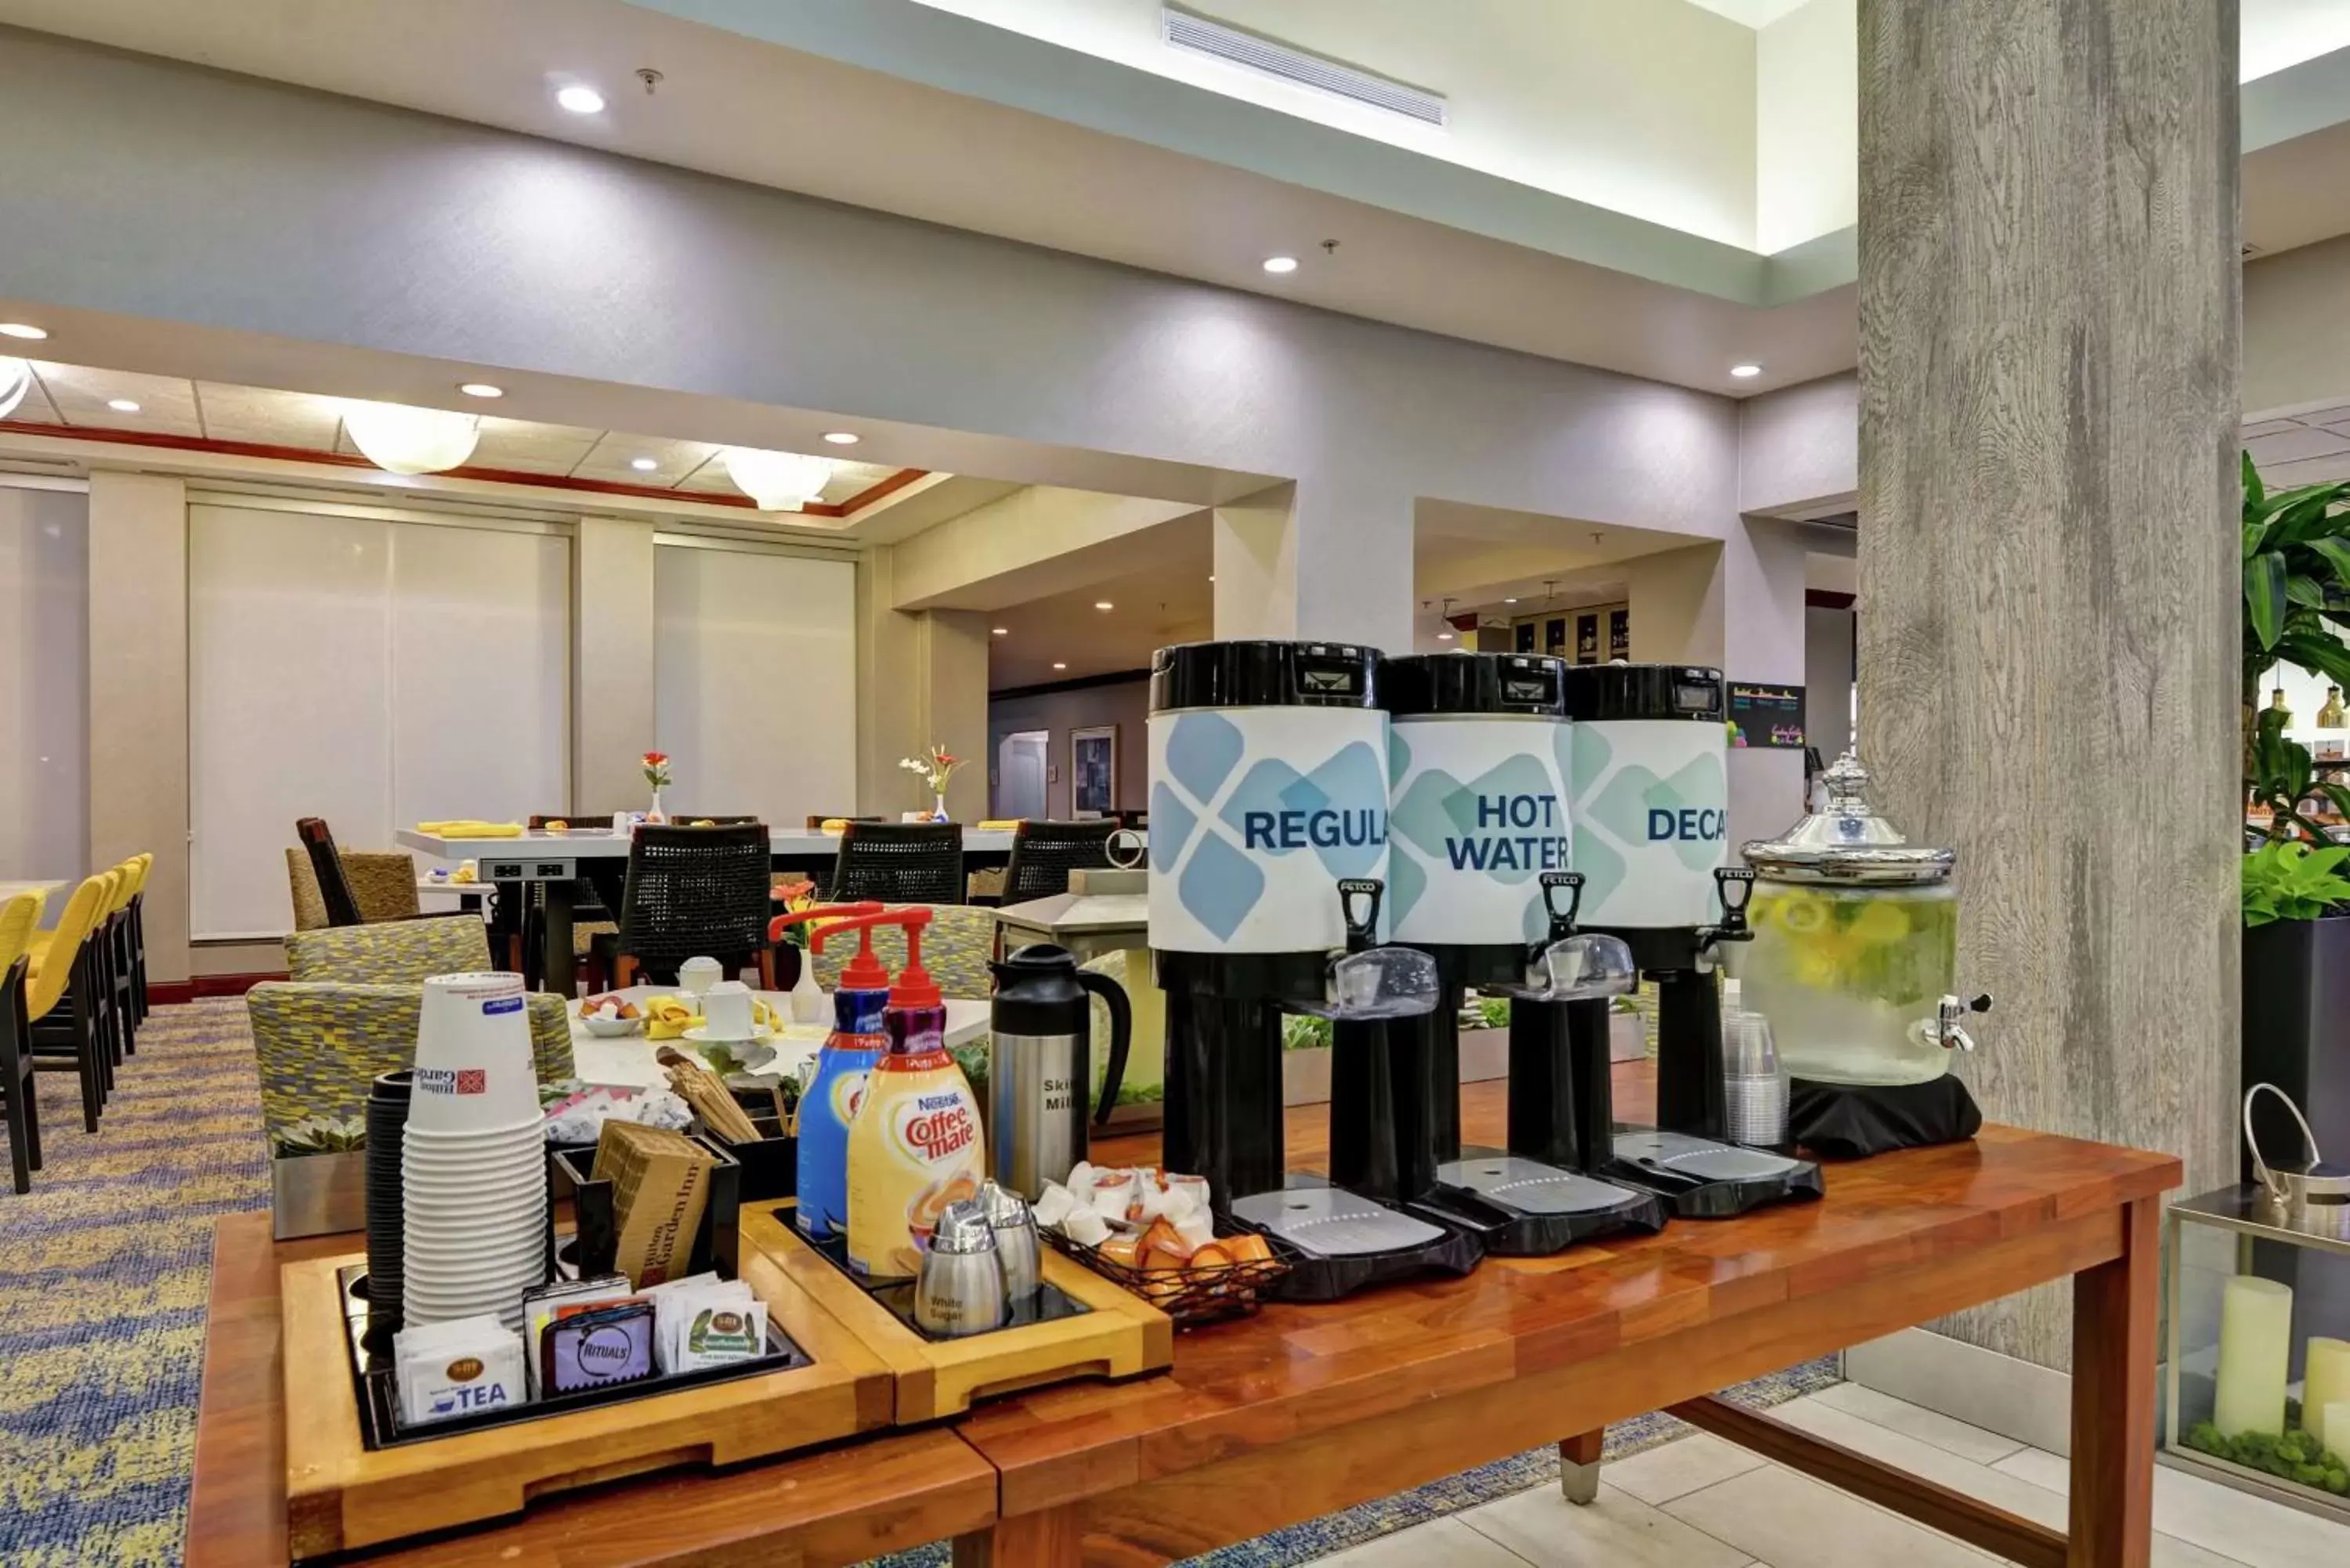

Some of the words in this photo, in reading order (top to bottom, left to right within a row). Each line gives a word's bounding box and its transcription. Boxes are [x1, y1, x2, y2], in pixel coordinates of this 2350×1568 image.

[1478, 794, 1556, 828] HOT
[1648, 808, 1728, 840] DECA
[1444, 836, 1568, 870] WATER
[1542, 876, 1578, 885] FETCO
[1719, 869, 1753, 878] FETCO
[1340, 882, 1376, 891] FETCO
[420, 1084, 454, 1095] Hilton
[1043, 1079, 1074, 1091] Ski
[1046, 1097, 1073, 1110] Mil
[906, 1105, 969, 1147] Coffee
[927, 1122, 974, 1160] mate
[656, 1201, 687, 1264] Garden
[677, 1165, 700, 1197] Inn
[644, 1226, 664, 1267] Hilton
[930, 1295, 963, 1309] White
[930, 1308, 962, 1321] Sugar
[583, 1344, 628, 1359] RITUALS
[457, 1382, 506, 1409] TEA
